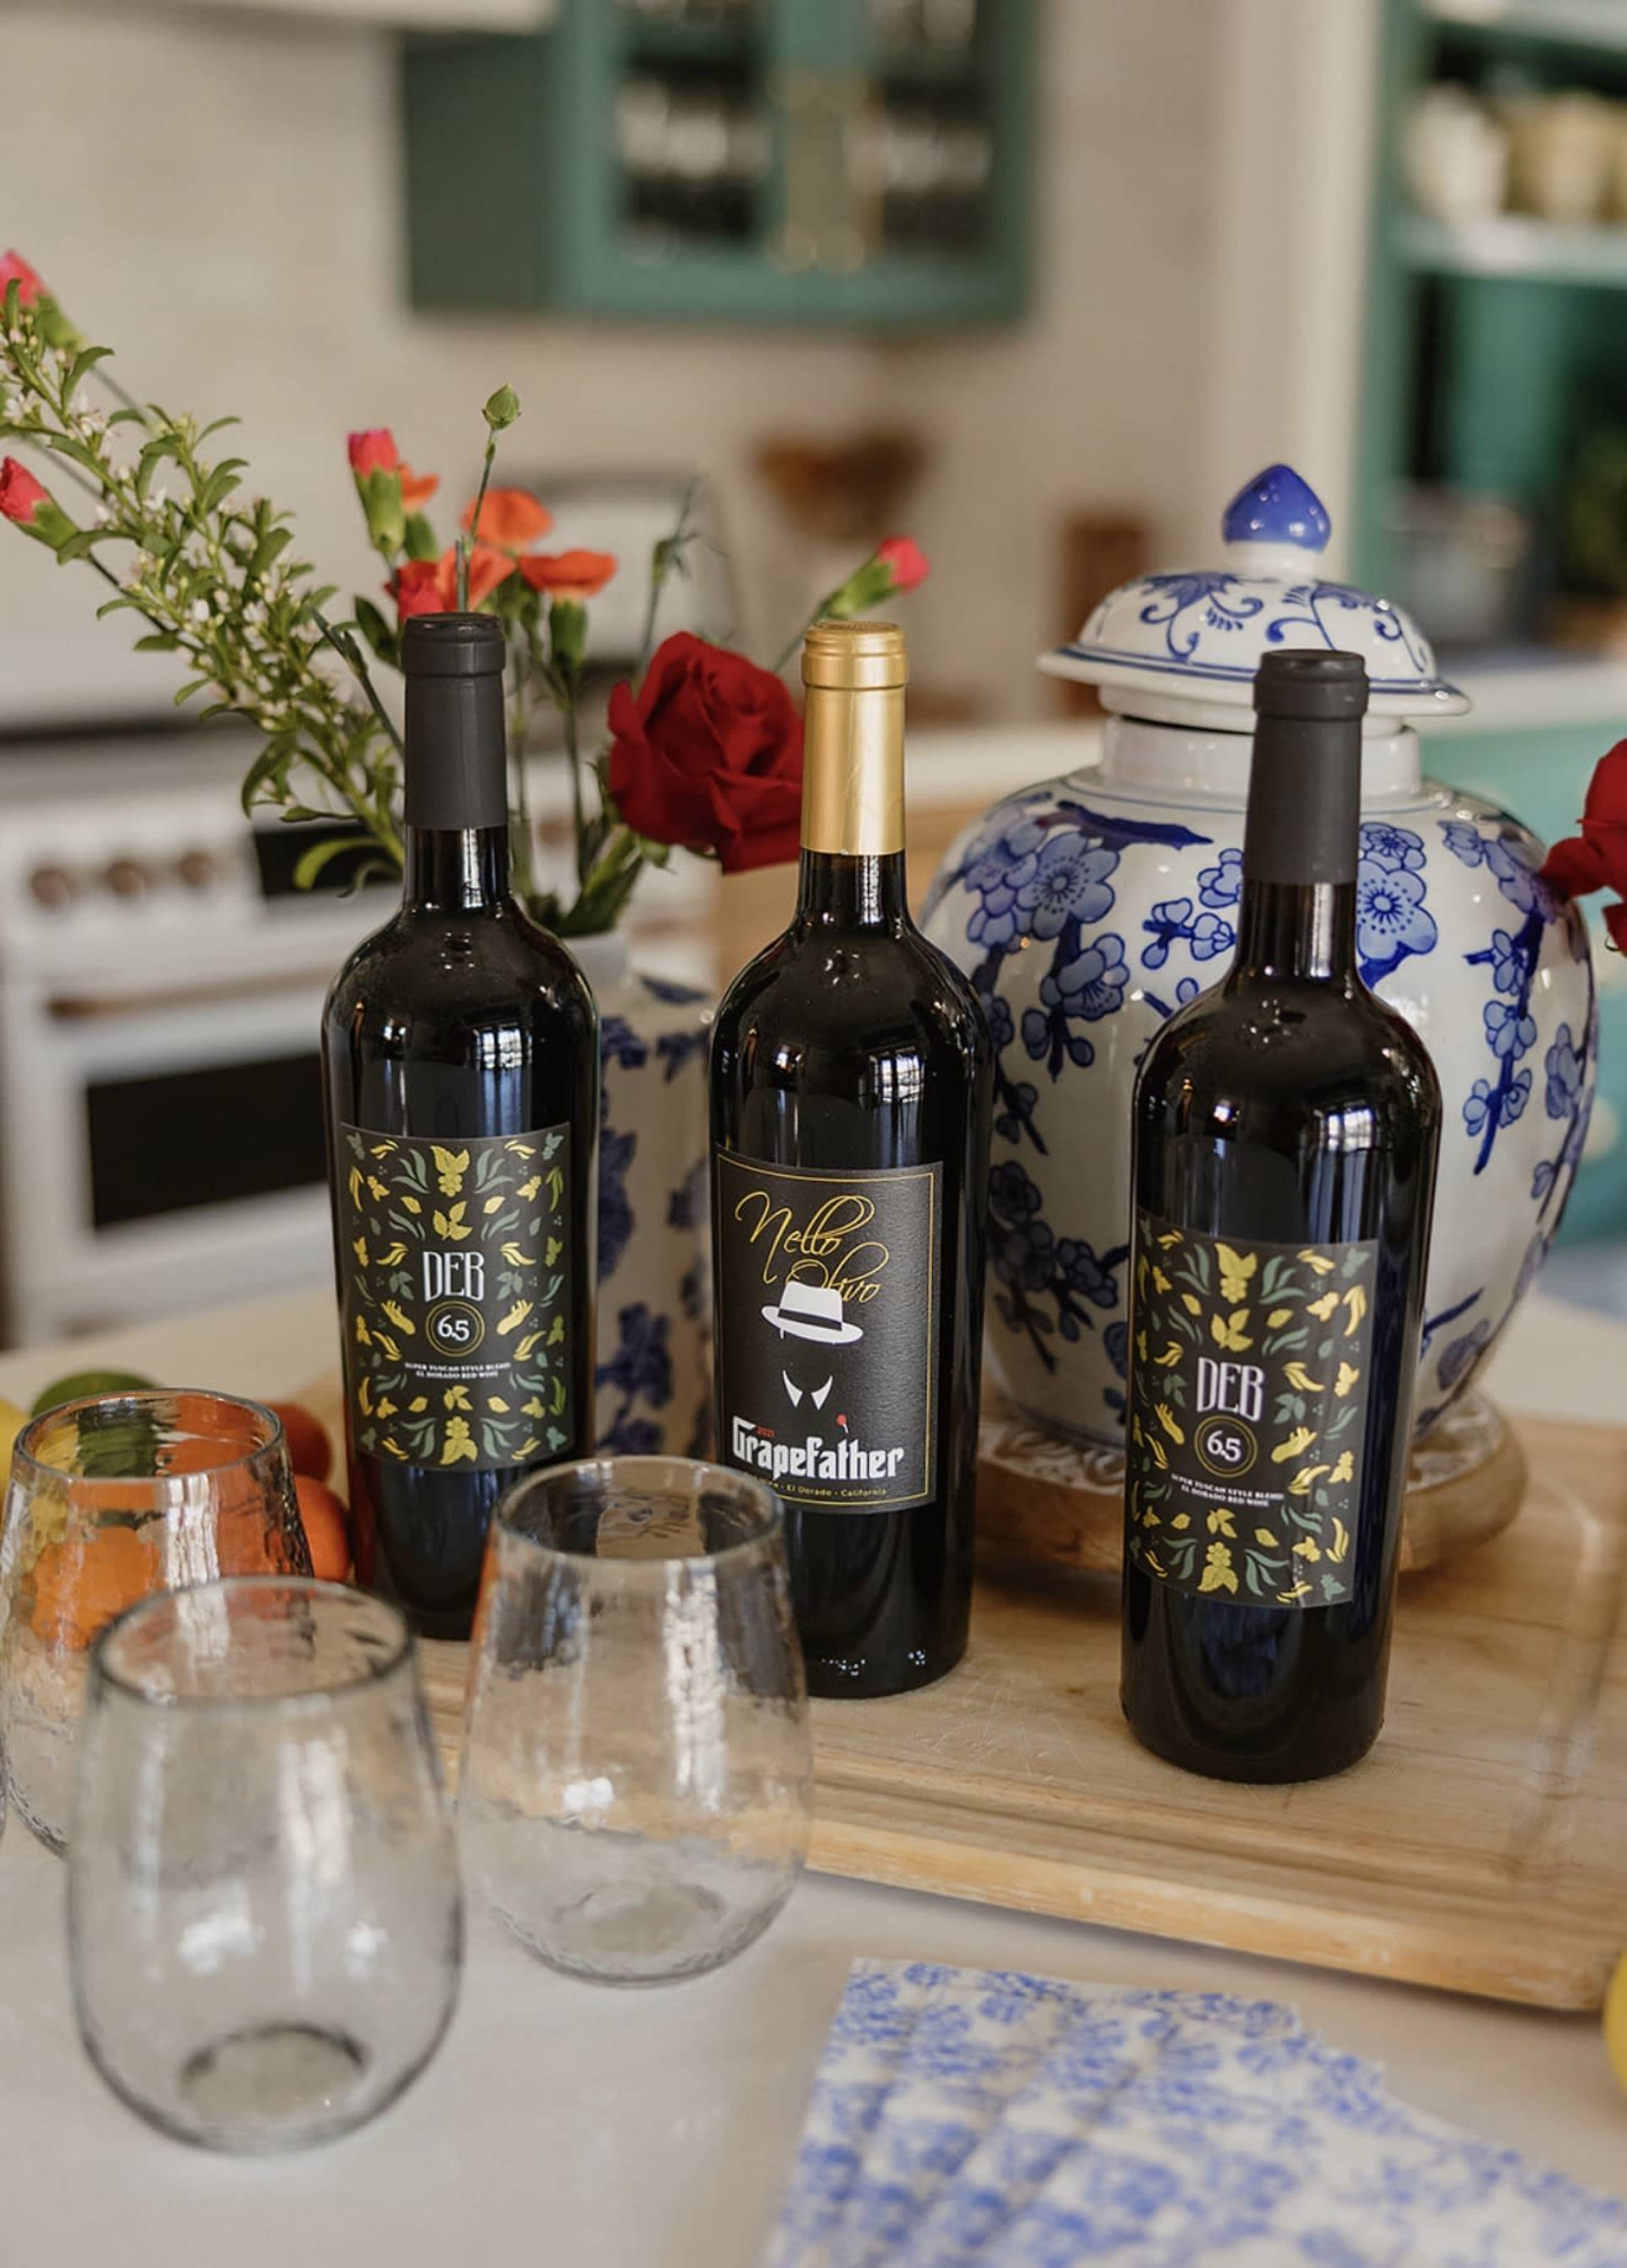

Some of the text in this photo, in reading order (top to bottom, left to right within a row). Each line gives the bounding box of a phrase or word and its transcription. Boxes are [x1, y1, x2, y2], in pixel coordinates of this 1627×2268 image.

[735, 1191, 875, 1284] Nello
[423, 1251, 484, 1302] DEB
[1197, 1357, 1265, 1422] DEB
[733, 1416, 904, 1480] Grapefather
[1191, 1488, 1226, 1501] DORADO
[1227, 1495, 1245, 1504] RED
[1228, 1488, 1252, 1497] STYLE
